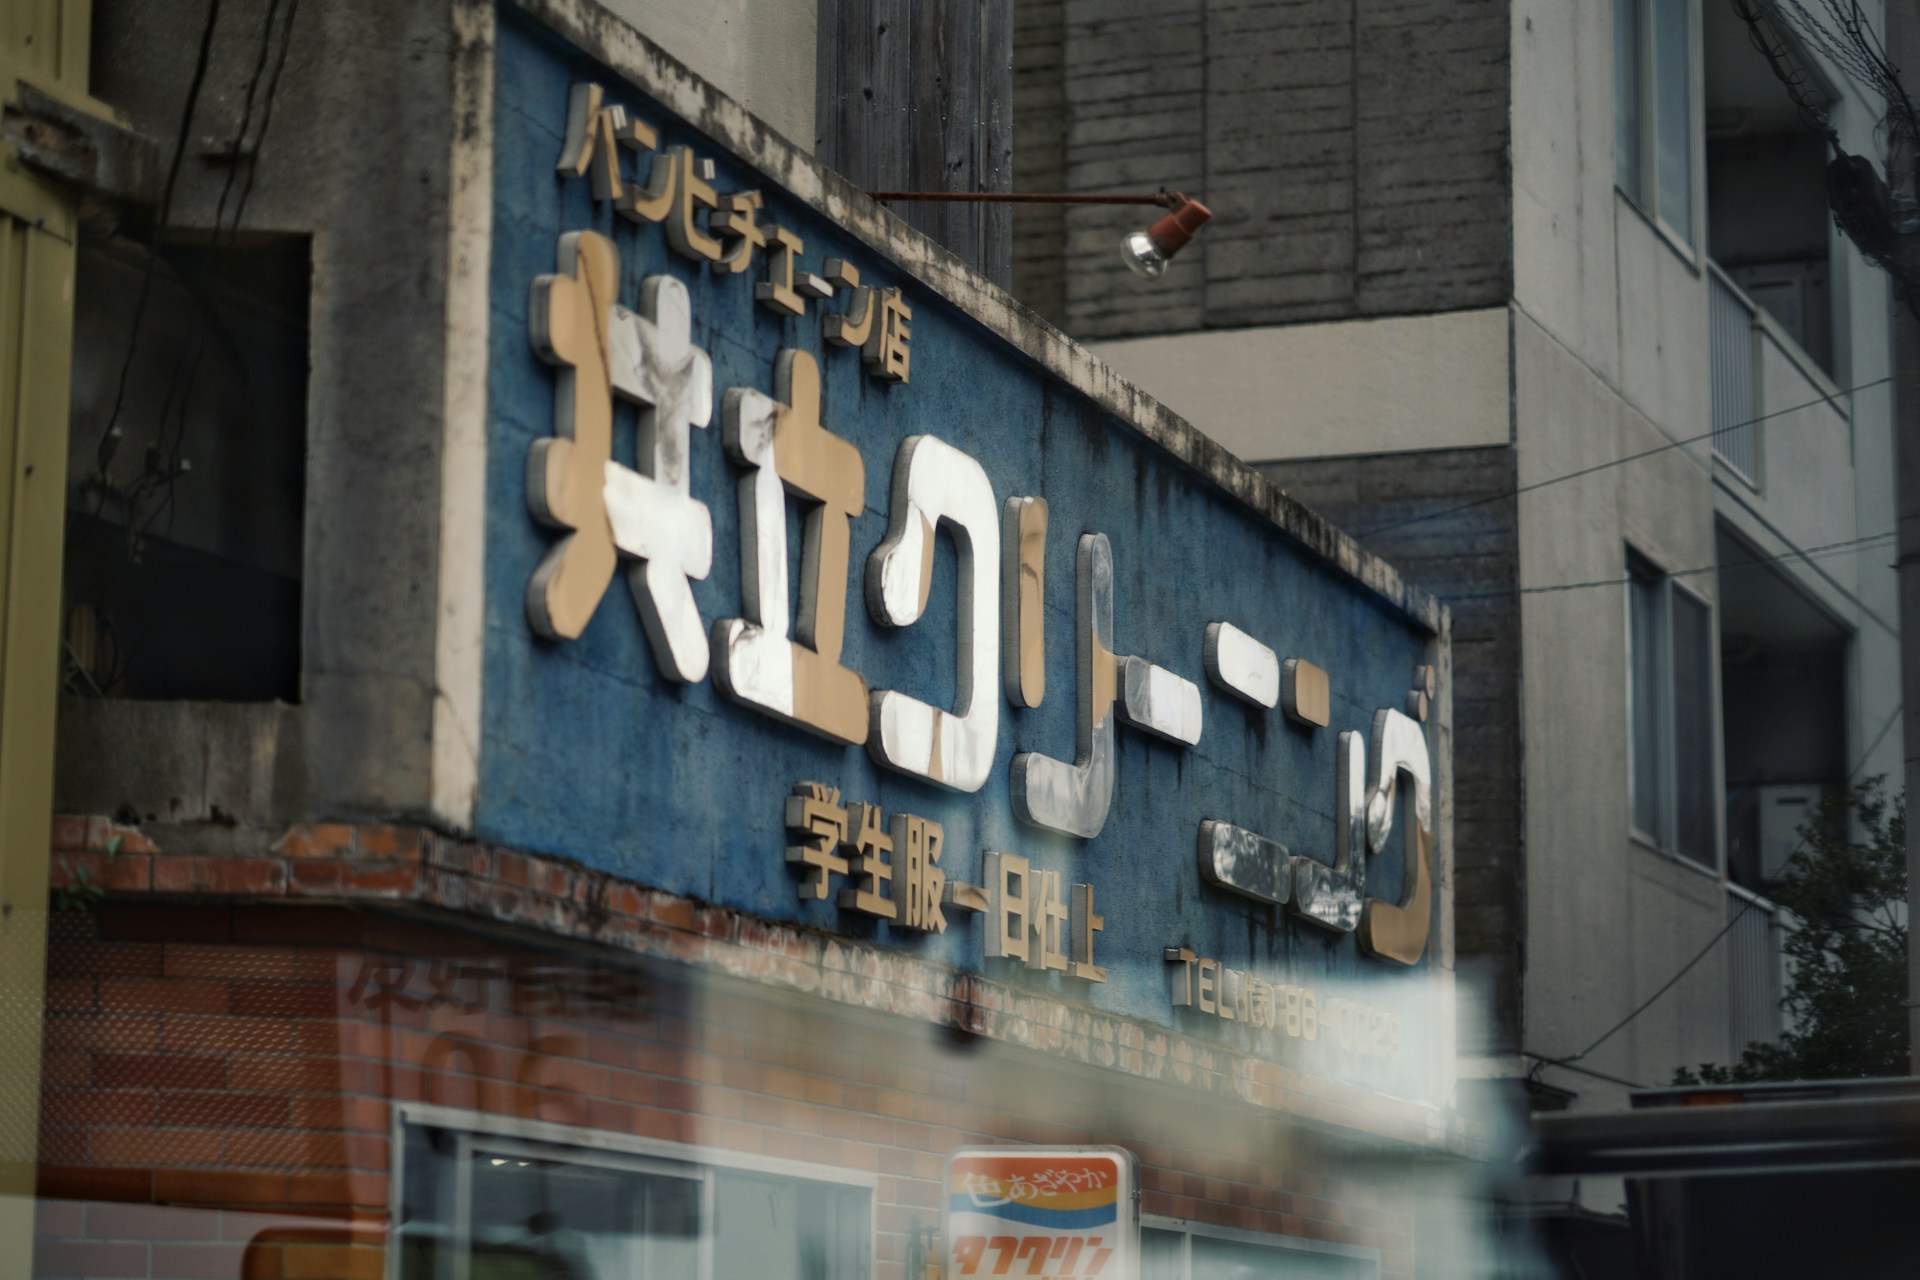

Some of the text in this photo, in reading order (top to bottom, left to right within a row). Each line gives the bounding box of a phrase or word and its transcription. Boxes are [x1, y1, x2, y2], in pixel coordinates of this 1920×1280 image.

[526, 230, 1434, 966] 共立クリーニング
[962, 1167, 1107, 1207] 色あざやか
[951, 1236, 1114, 1275] タフクリン
